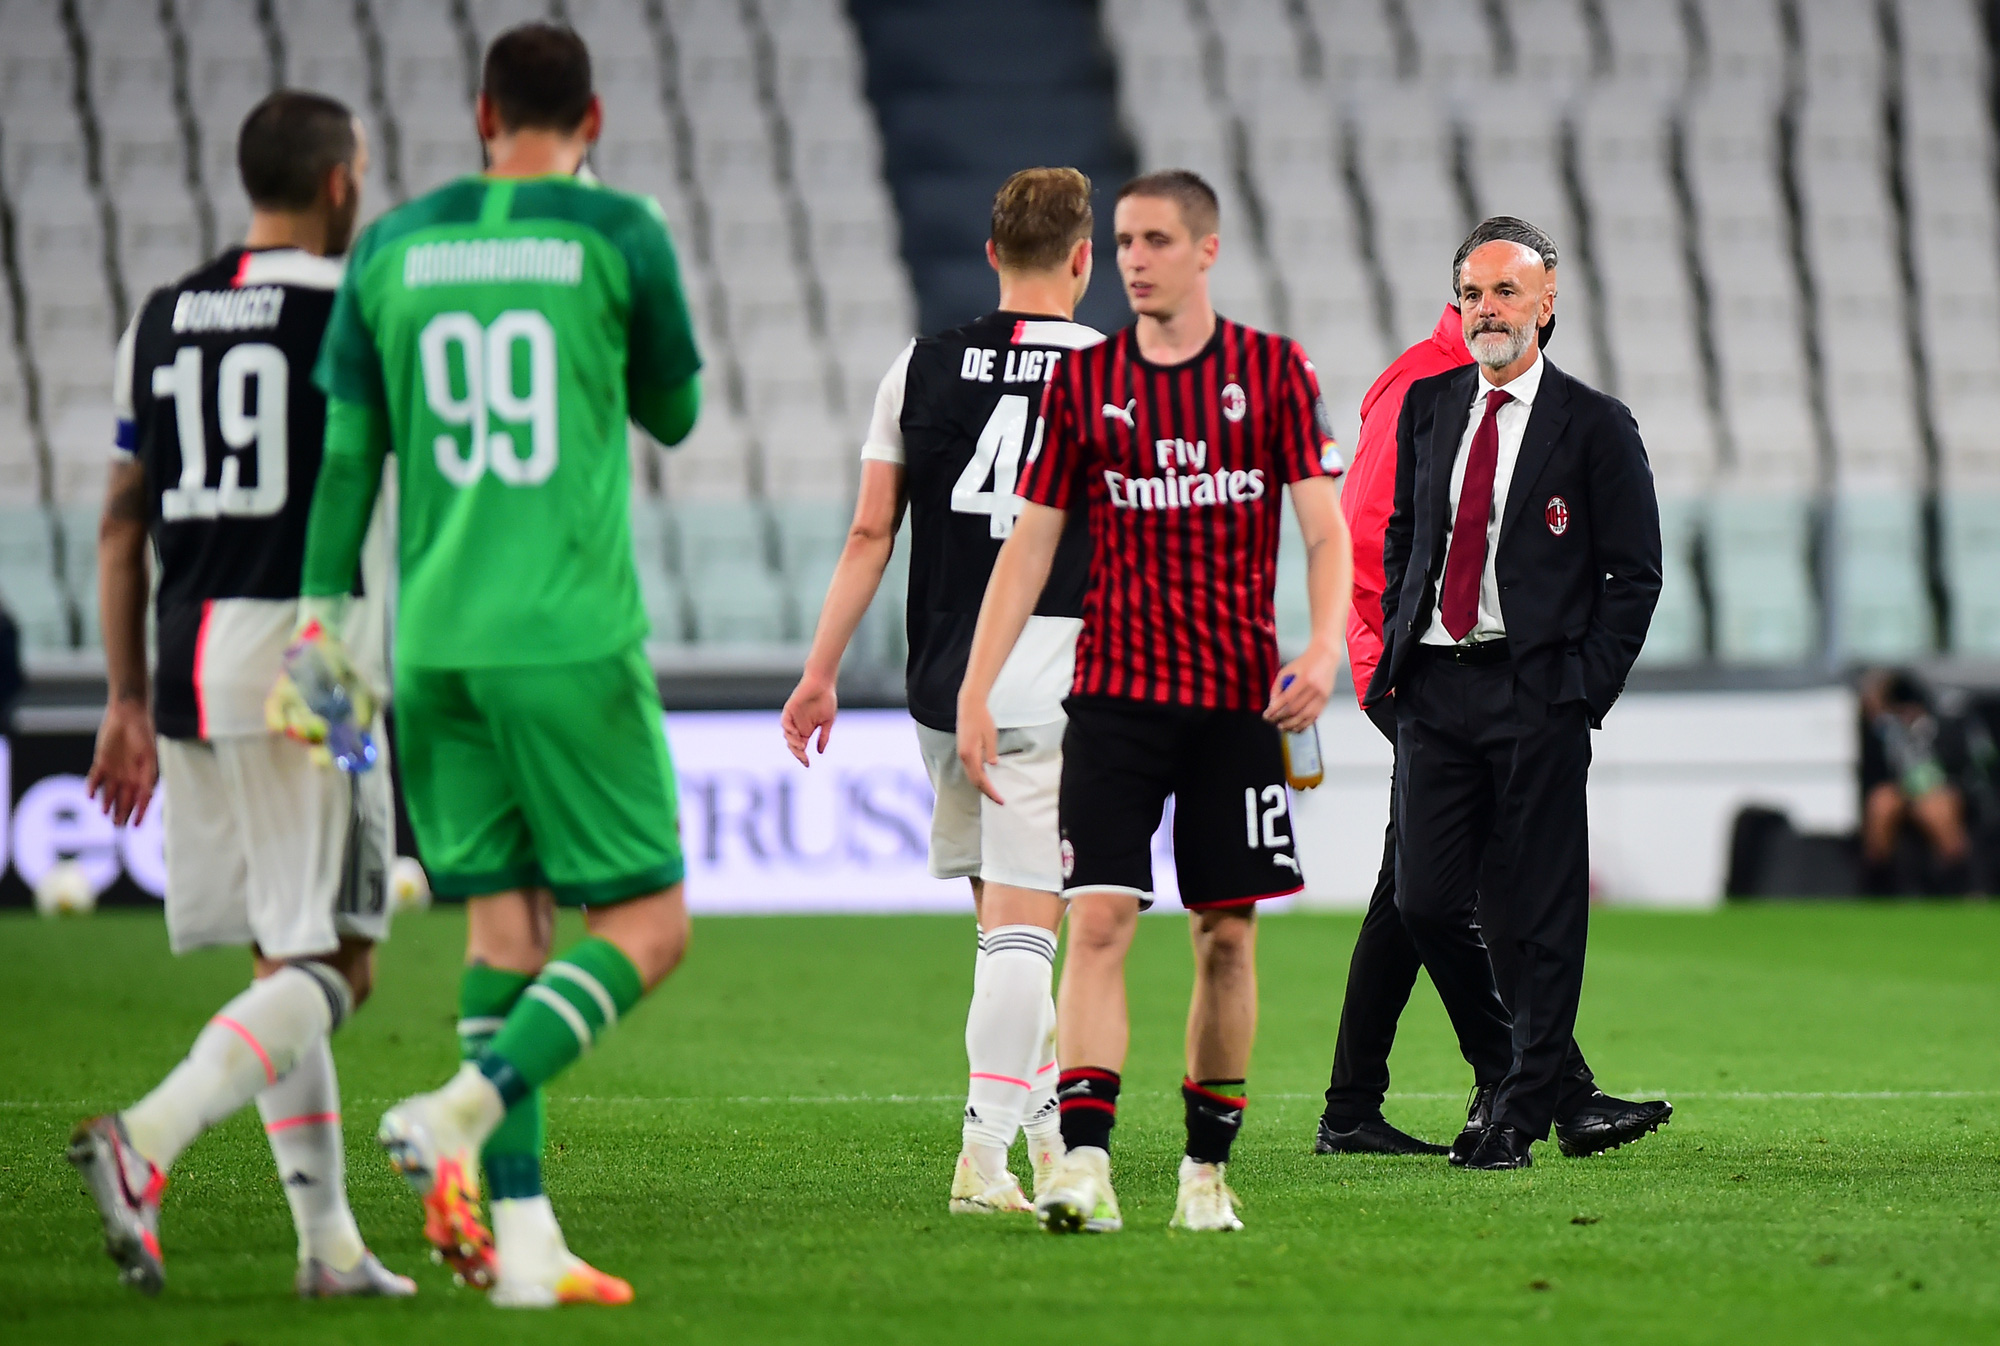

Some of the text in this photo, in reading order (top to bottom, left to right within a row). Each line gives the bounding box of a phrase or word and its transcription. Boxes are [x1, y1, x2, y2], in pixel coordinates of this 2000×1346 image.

[172, 285, 286, 334] BONUCCI
[960, 347, 1062, 383] DE LIGT
[418, 308, 559, 488] 99
[151, 341, 290, 522] 19
[1155, 437, 1207, 470] Fly
[950, 393, 1028, 540] 4
[1103, 466, 1265, 511] Emirates
[1245, 783, 1290, 849] 12
